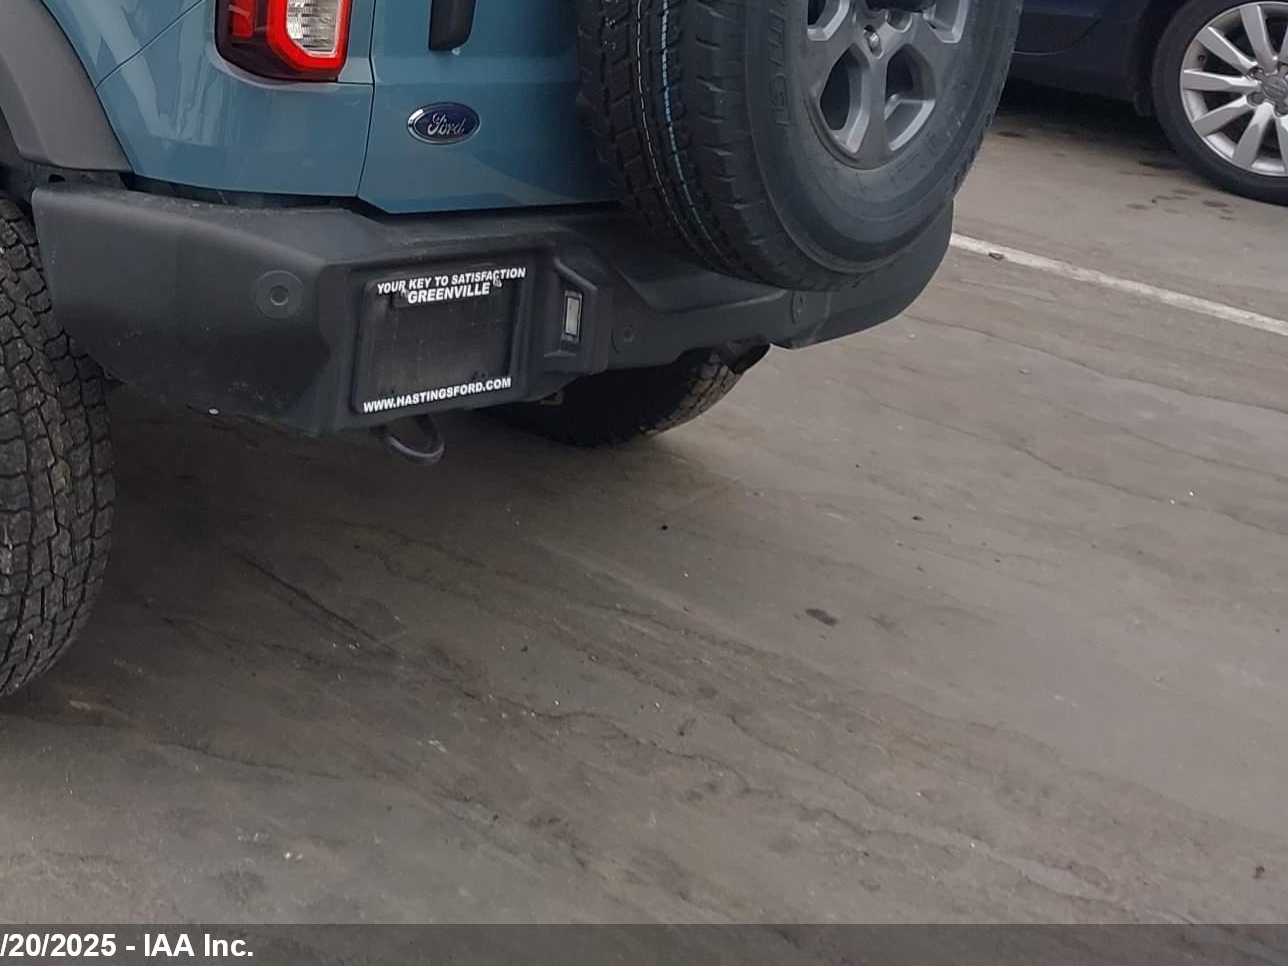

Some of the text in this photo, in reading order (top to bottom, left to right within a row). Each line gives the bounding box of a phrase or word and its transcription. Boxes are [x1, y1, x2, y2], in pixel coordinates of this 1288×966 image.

[377, 267, 525, 294] YOUR KEY TO SATISFACTION
[407, 282, 490, 303] GREENVILLE
[363, 377, 511, 412] WWW.HASTINGSFORD.COM
